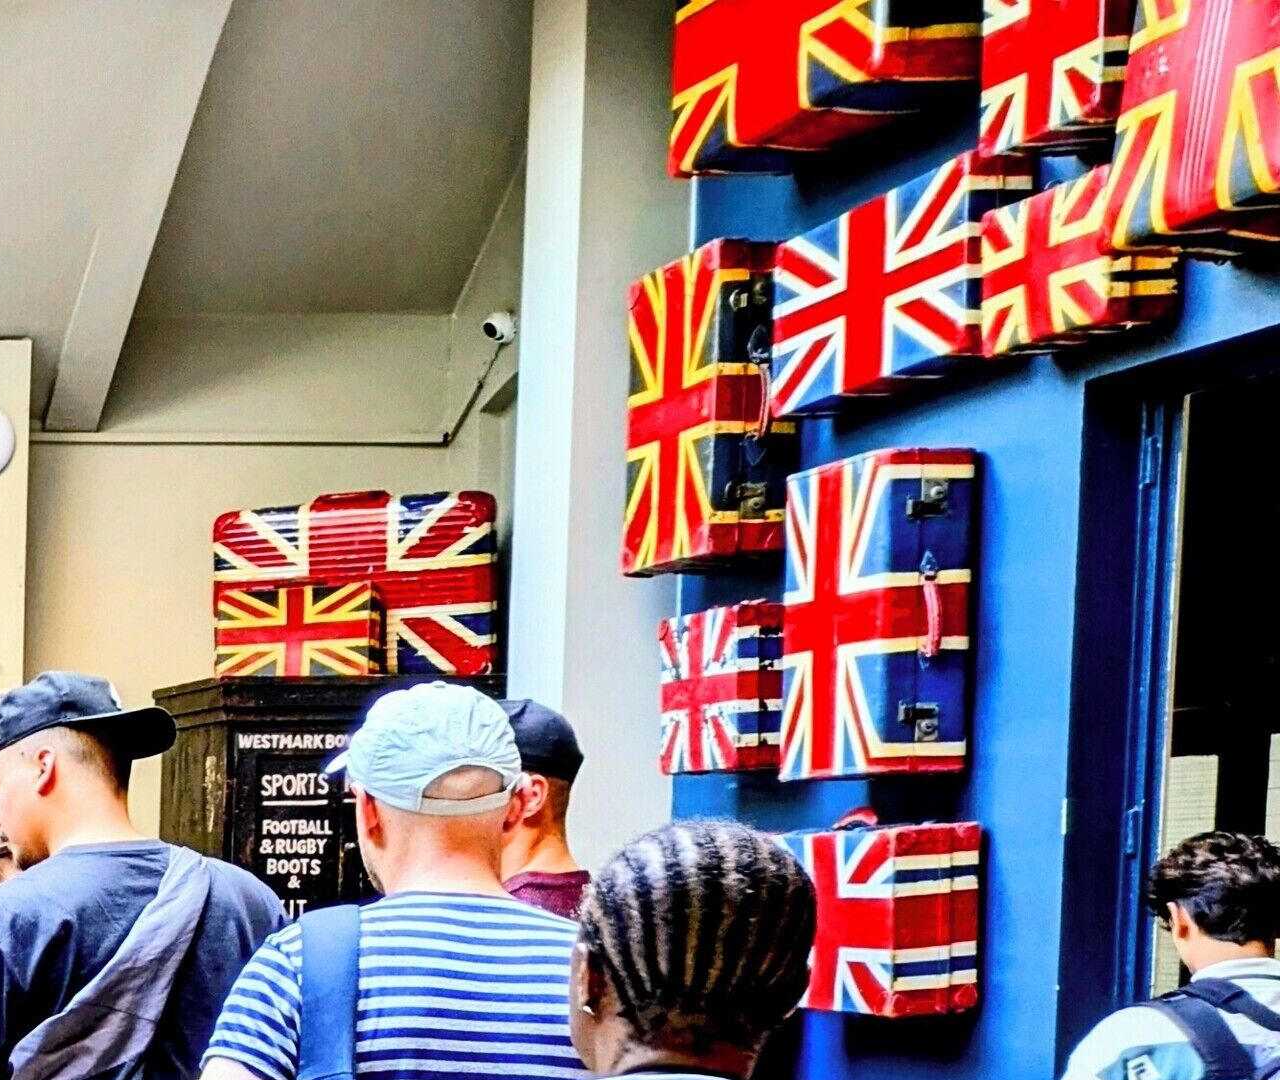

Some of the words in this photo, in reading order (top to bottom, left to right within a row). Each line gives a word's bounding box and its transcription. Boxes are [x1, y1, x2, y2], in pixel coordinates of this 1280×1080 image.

[238, 733, 324, 749] WESTMARK
[260, 773, 329, 797] SPORTS
[261, 819, 333, 835] FOOTBALL
[266, 858, 322, 875] BOOTS
[287, 875, 301, 889] &
[280, 899, 307, 919] IT
